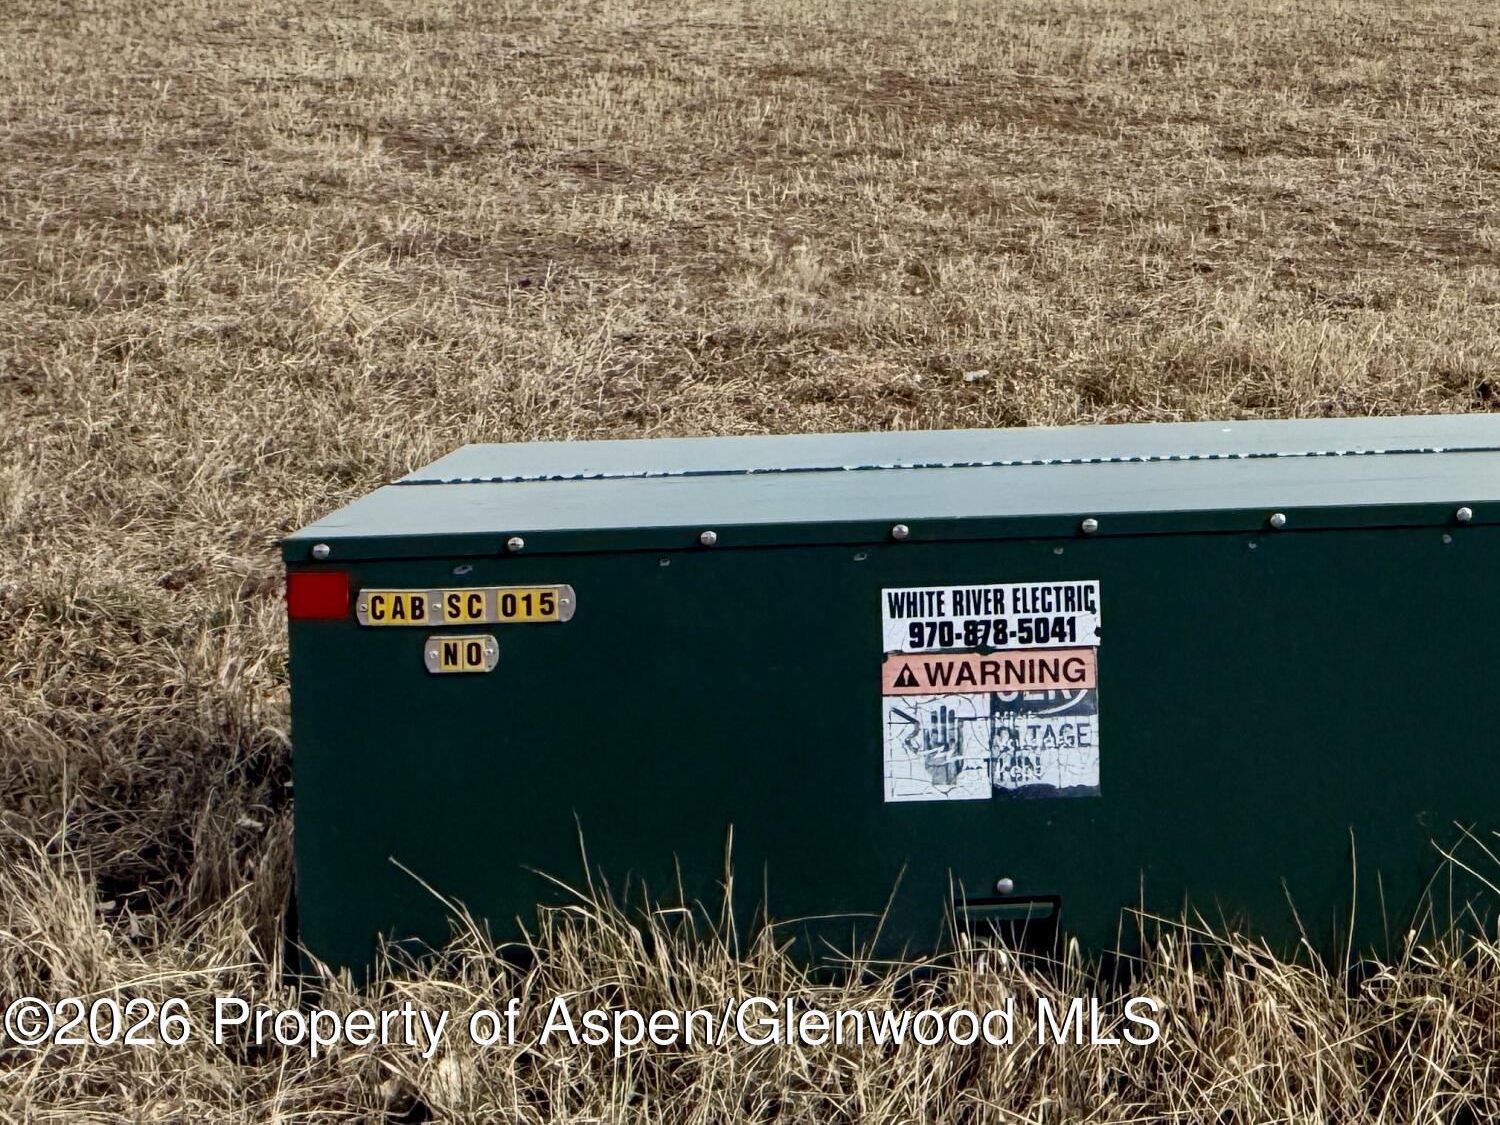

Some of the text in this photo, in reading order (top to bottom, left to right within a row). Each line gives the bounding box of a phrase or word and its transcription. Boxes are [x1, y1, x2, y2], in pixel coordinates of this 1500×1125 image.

[371, 592, 425, 621] CAB
[447, 593, 483, 619] SC
[888, 585, 1096, 618] WHITE RIVER ELECTRIC
[909, 616, 1077, 649] 970-878-5041
[444, 642, 482, 666] NO
[924, 657, 1086, 687] WARNING
